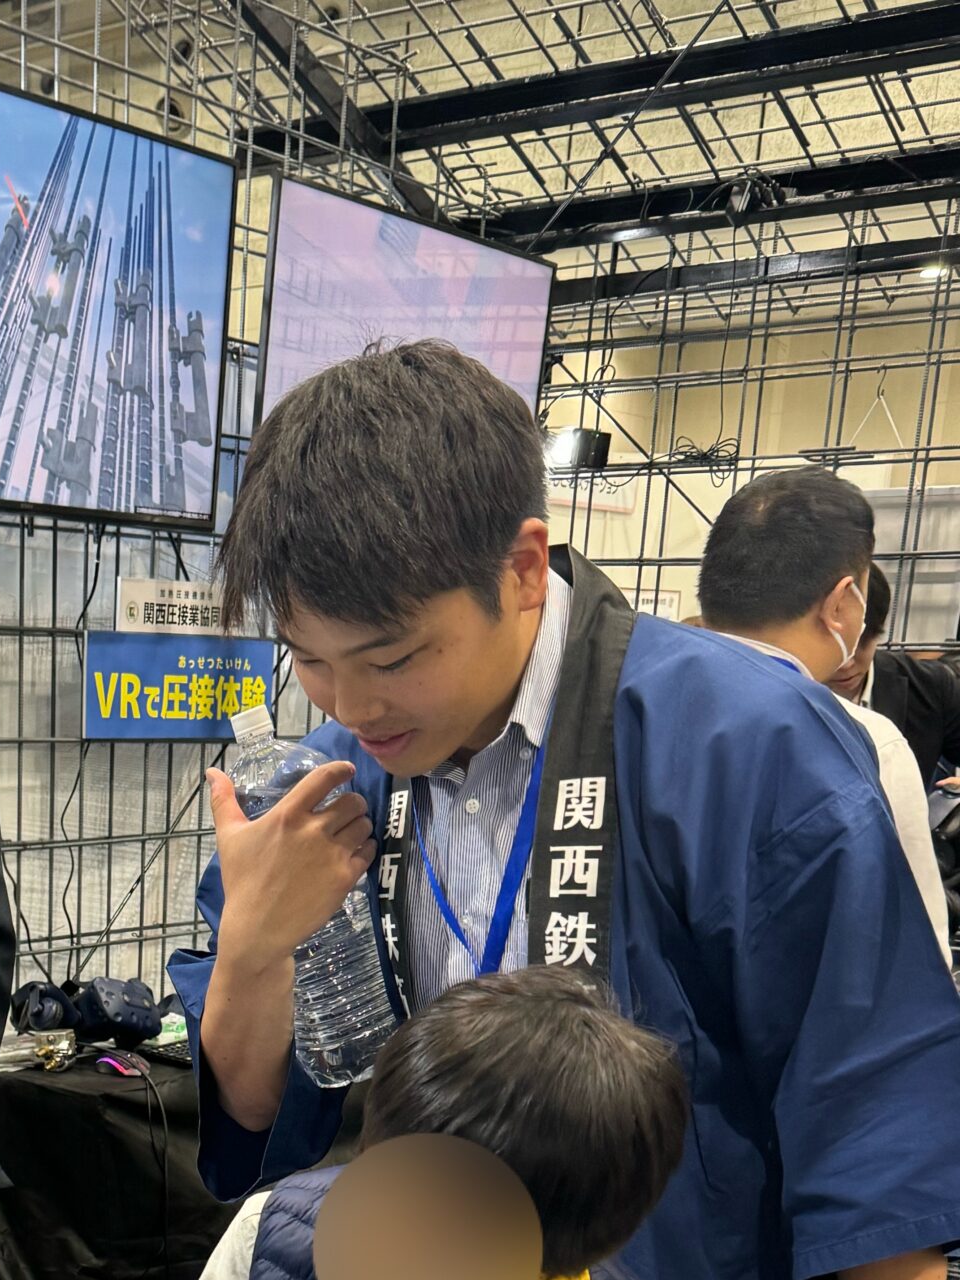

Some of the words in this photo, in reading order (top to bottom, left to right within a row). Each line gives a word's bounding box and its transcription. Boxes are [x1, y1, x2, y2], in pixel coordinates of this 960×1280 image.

[143, 602, 221, 628] 関西圧接業協同
[94, 671, 267, 721] VRで圧接体験
